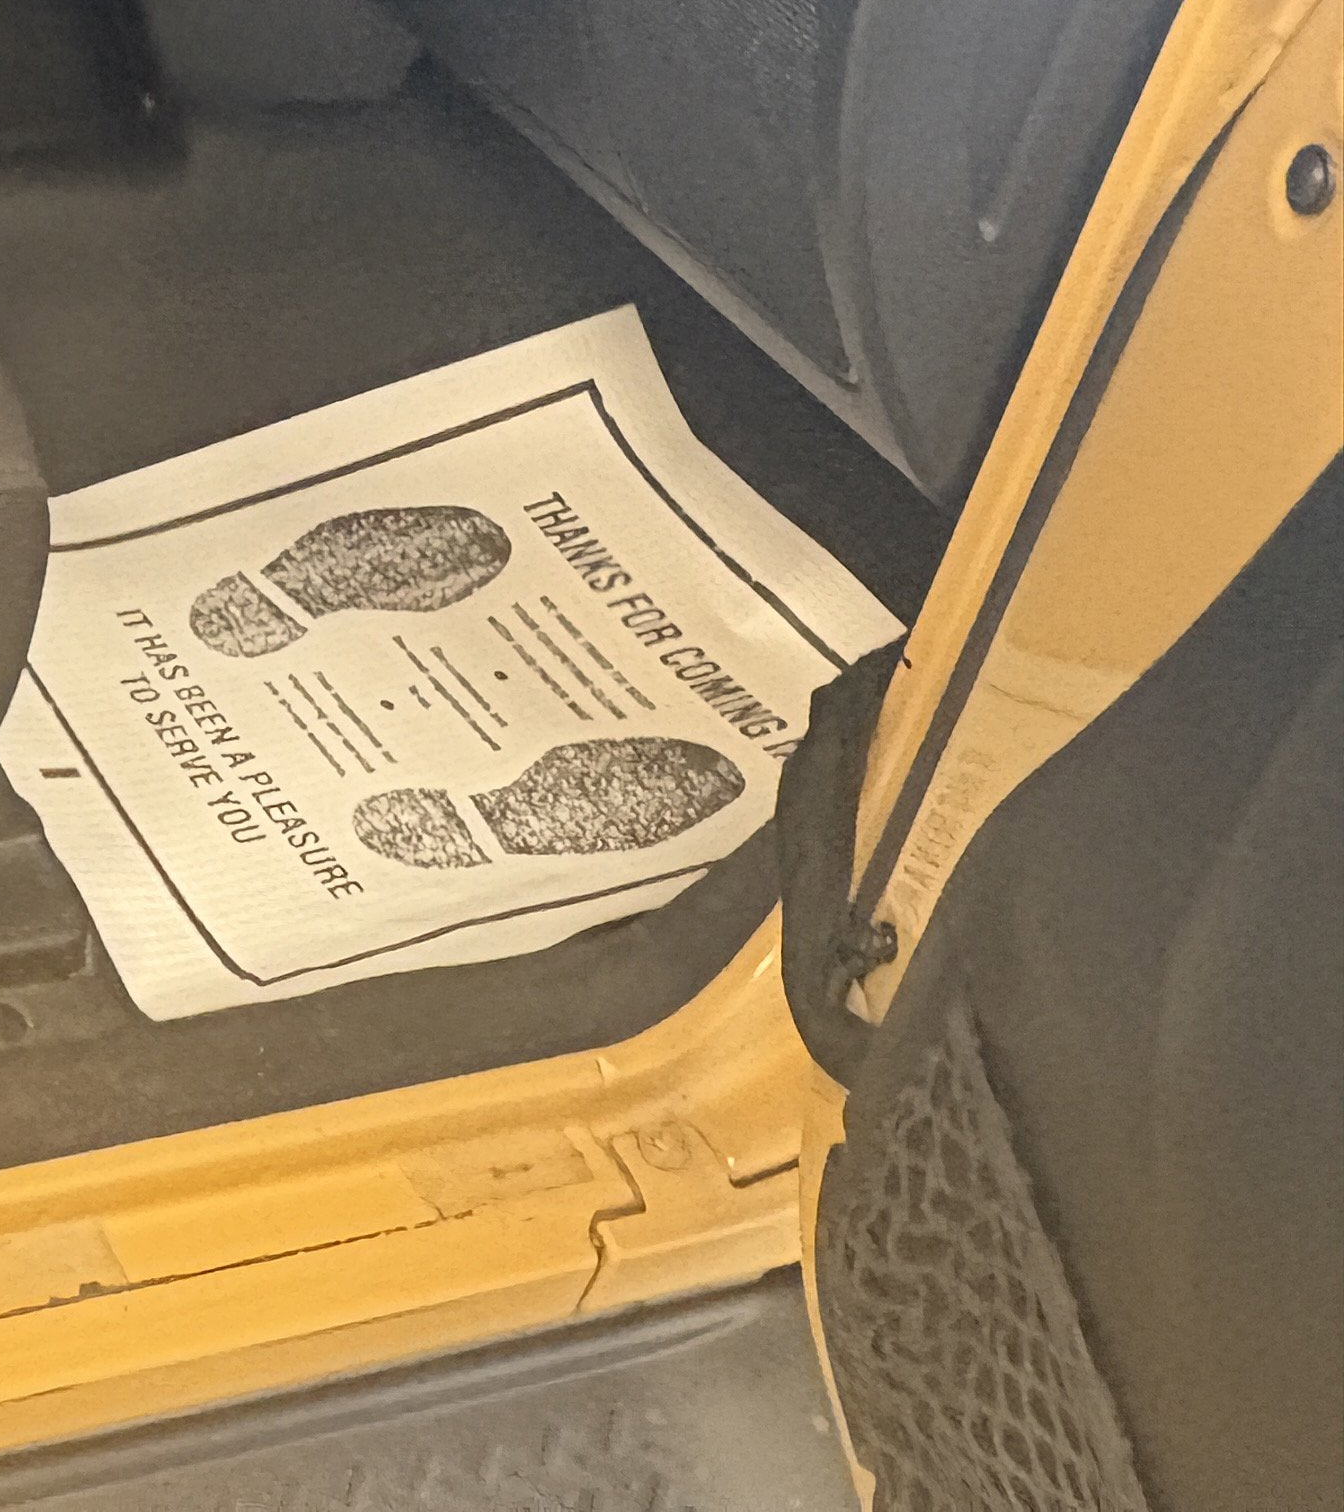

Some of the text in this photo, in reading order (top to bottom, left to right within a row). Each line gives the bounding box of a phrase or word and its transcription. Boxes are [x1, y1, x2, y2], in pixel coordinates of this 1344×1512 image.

[116, 608, 154, 628] IT
[523, 491, 632, 592] THANKS
[607, 592, 683, 647] FOR
[659, 646, 788, 739] COMING
[134, 633, 189, 680] HAS
[174, 684, 240, 745] BEEN
[120, 671, 266, 843] TO SERVE YOU
[221, 752, 256, 768] A
[238, 771, 364, 900] PLEASURE
